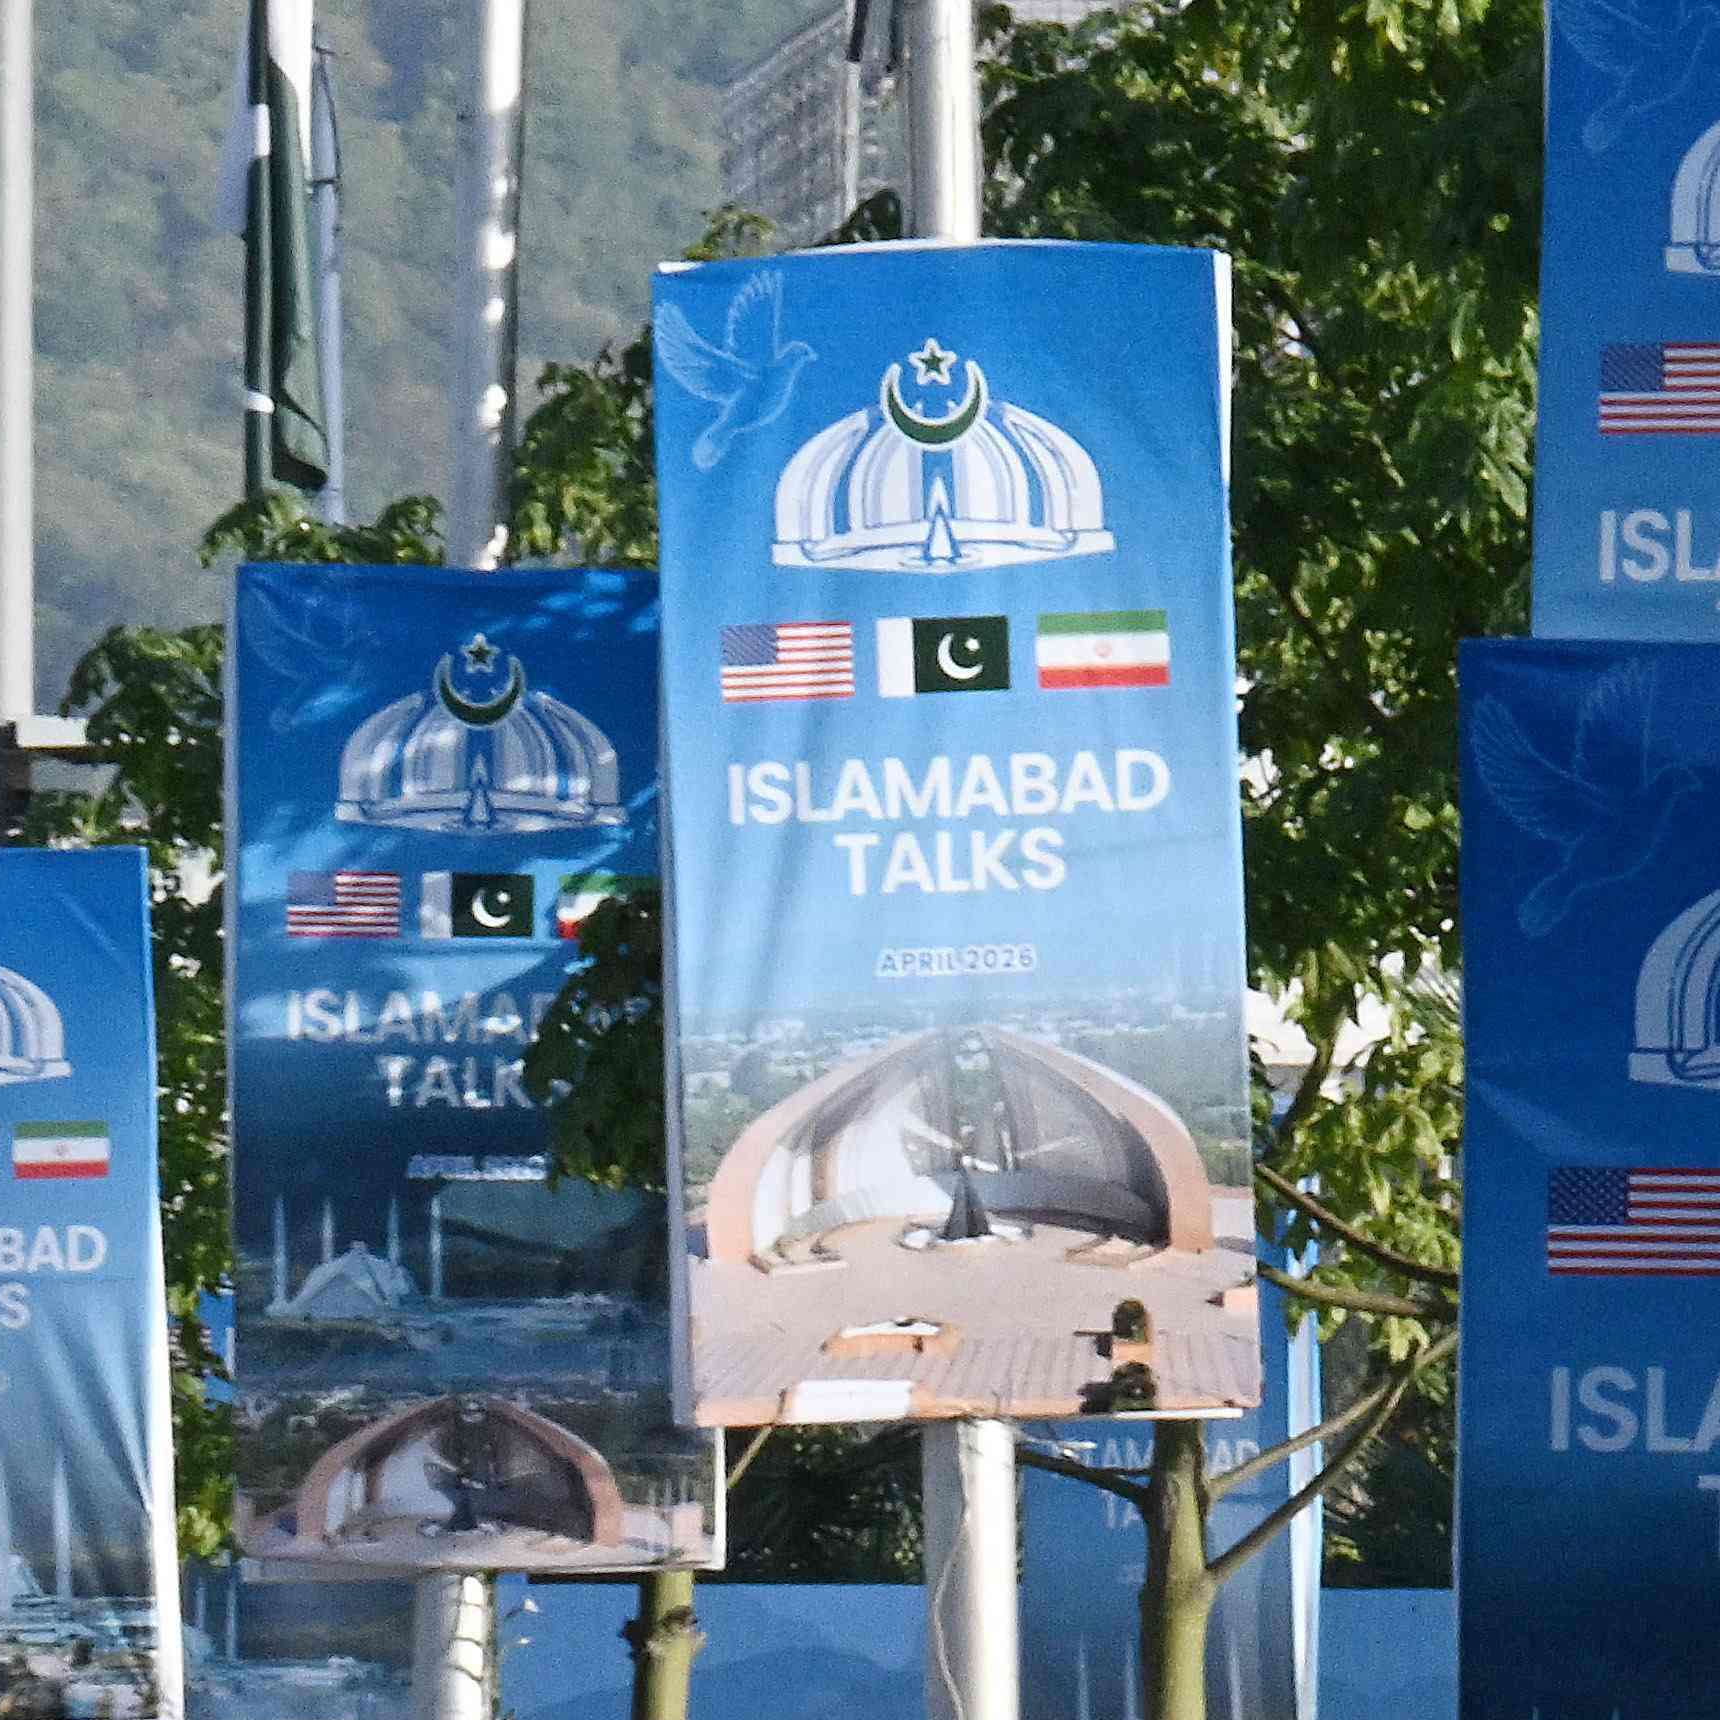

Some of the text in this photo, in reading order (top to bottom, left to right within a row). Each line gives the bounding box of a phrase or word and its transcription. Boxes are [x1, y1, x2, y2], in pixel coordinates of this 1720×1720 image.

[728, 749, 1171, 825] ISLAMABAD
[833, 826, 1068, 896] TALKS
[877, 946, 1037, 976] APRIL 2026
